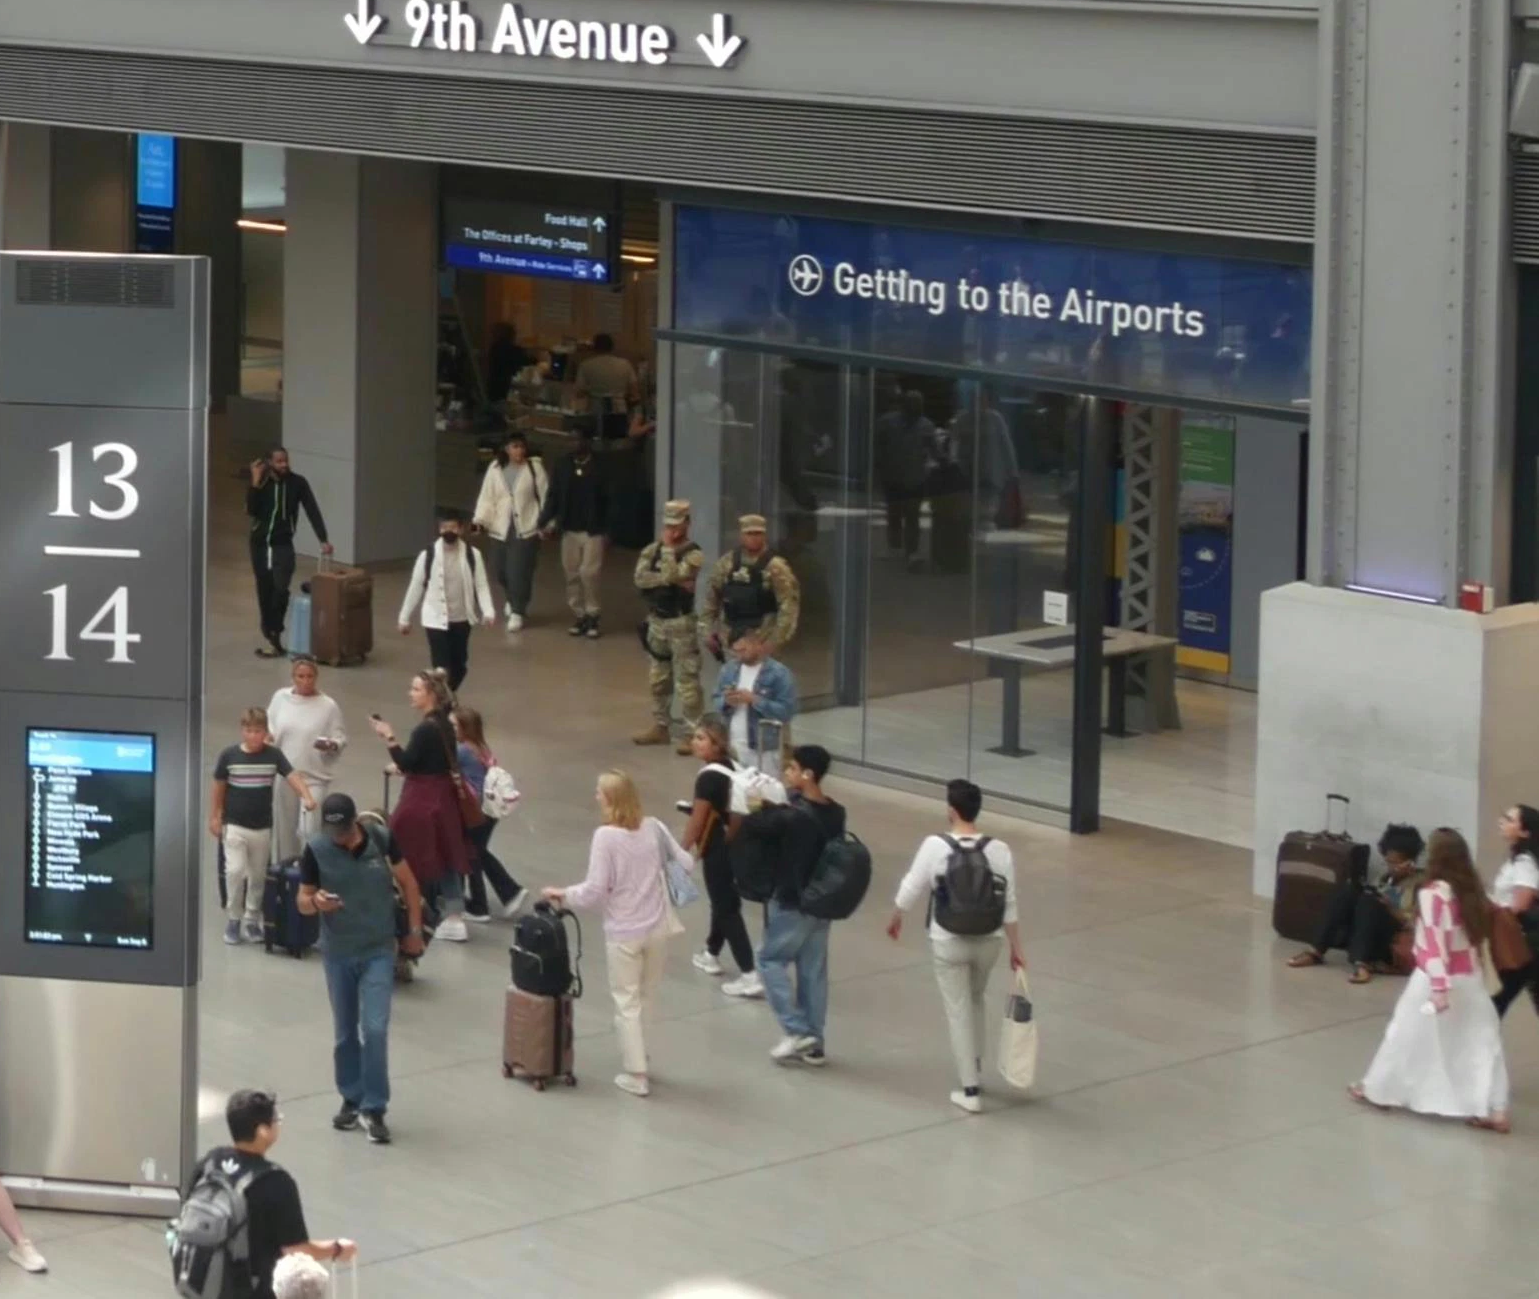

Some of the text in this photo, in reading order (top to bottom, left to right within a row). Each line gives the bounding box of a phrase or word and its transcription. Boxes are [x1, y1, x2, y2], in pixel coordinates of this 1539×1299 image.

[491, 2, 670, 65] Avenue
[463, 227, 588, 253] The Offices at Farley Shops
[544, 212, 588, 228] Food Hall
[495, 253, 526, 268] Avenue
[832, 261, 1205, 337] Getting to the Airports
[48, 440, 140, 520] 13
[42, 583, 142, 664] 14
